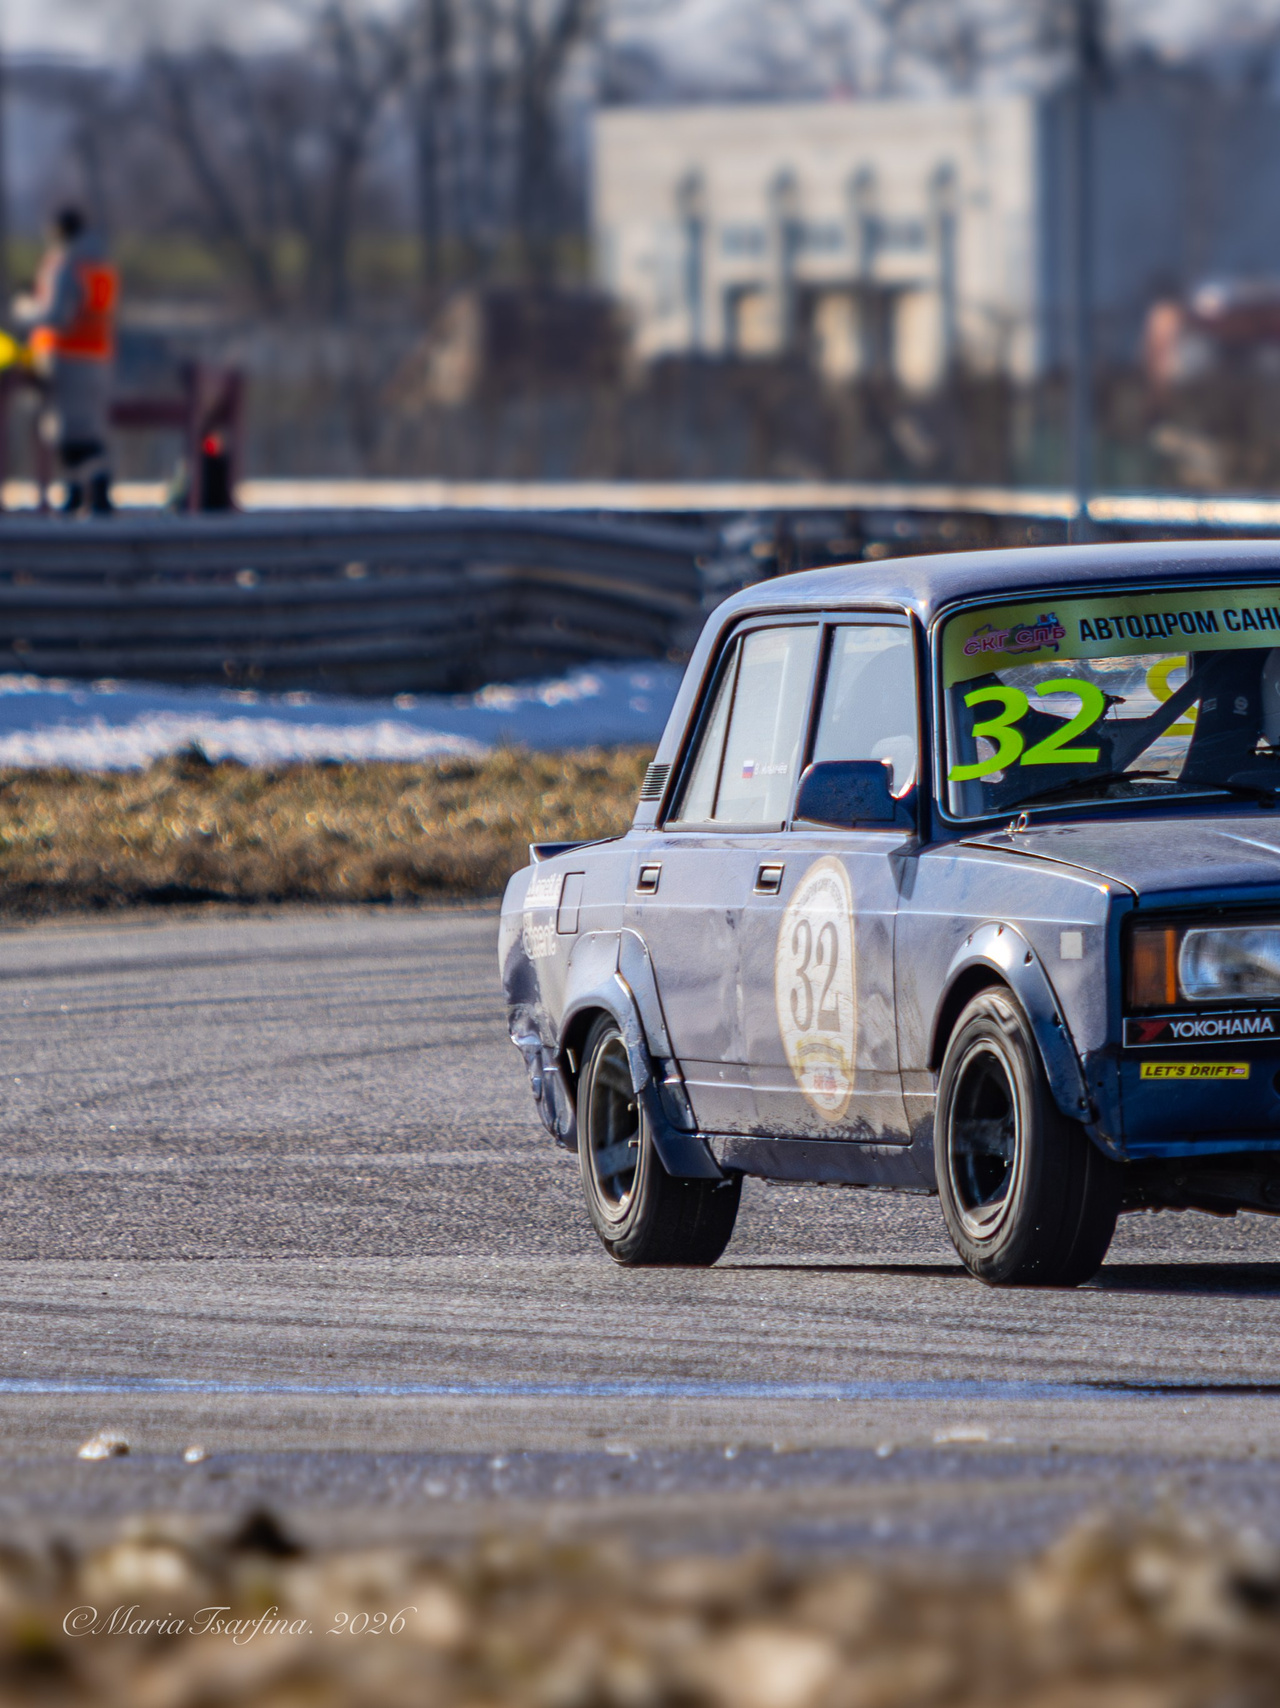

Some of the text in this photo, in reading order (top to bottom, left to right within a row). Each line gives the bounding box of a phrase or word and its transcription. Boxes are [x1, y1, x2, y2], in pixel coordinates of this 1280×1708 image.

[963, 626, 1067, 656] СКГ СПБ
[1079, 609, 1220, 642] АВТОДРОМ
[947, 678, 1105, 782] 32
[789, 918, 840, 1033] 32
[1169, 1016, 1274, 1038] YOKOHAMA
[1145, 1066, 1186, 1077] LET'S
[1190, 1066, 1234, 1077] DRIFT
